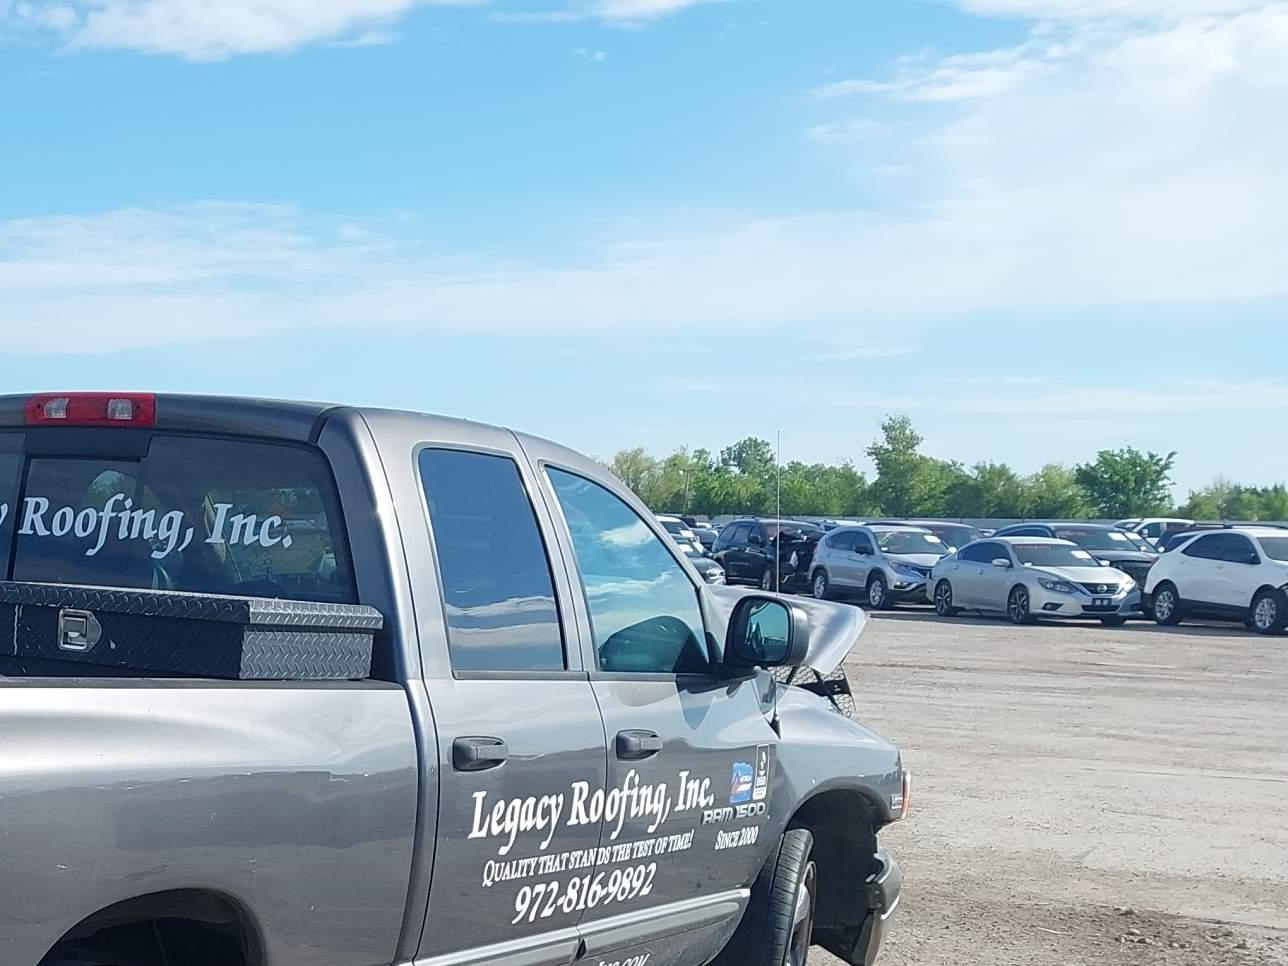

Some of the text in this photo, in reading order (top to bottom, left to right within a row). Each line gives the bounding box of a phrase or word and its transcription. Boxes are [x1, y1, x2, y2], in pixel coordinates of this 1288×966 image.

[18, 493, 195, 559] Roofing,
[204, 503, 294, 550] Inc.
[468, 769, 715, 855] Legacy Roofing, Inc.
[702, 802, 766, 825] RAM 1500
[715, 826, 759, 850] SINCE 2000
[481, 858, 539, 888] QUALITY
[538, 853, 567, 875] THAT
[611, 845, 631, 862] THE
[632, 839, 655, 857] TEST
[653, 837, 669, 855] OF
[666, 829, 695, 852] TIME!
[511, 862, 658, 925] 972-816-9892
